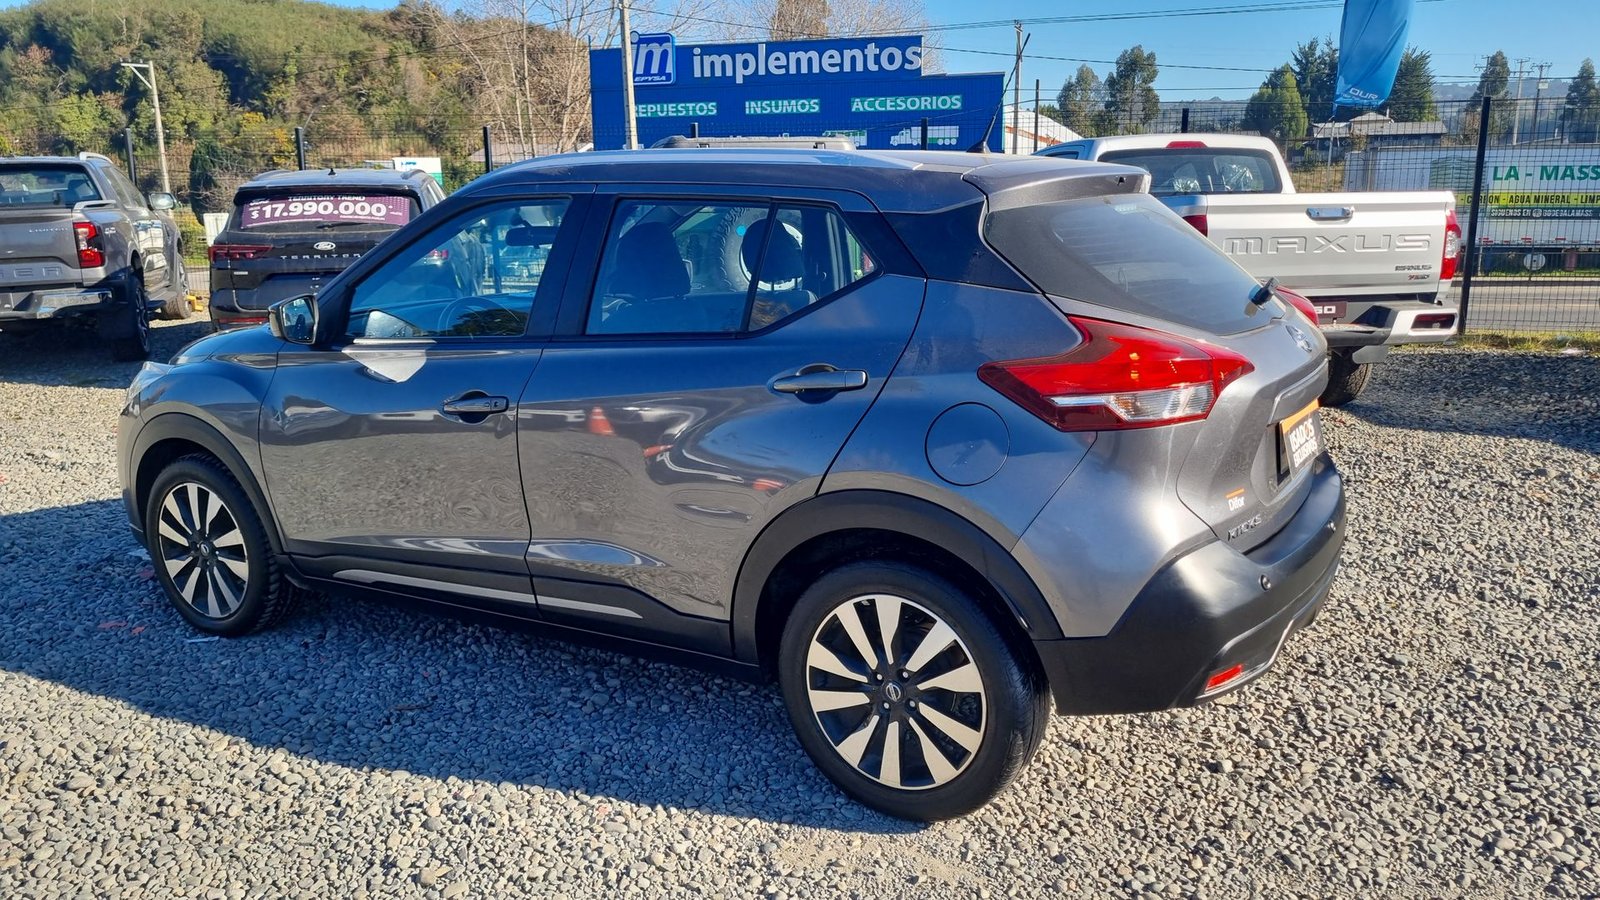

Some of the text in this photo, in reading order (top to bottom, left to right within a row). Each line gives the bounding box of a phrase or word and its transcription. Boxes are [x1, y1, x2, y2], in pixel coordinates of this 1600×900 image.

[693, 43, 921, 84] implementos
[745, 99, 820, 115] INSUMOS
[852, 95, 962, 113] ACCESORIOS
[1493, 165, 1520, 181] LA
[1539, 165, 1600, 181] MASS
[1466, 194, 1500, 204] CRON
[1508, 194, 1531, 204] AGUA
[1533, 194, 1571, 204] MINERAL
[251, 210, 259, 220] $
[262, 201, 387, 219] 17.990.000
[1222, 233, 1432, 256] MAXUS
[0, 266, 62, 279] ER
